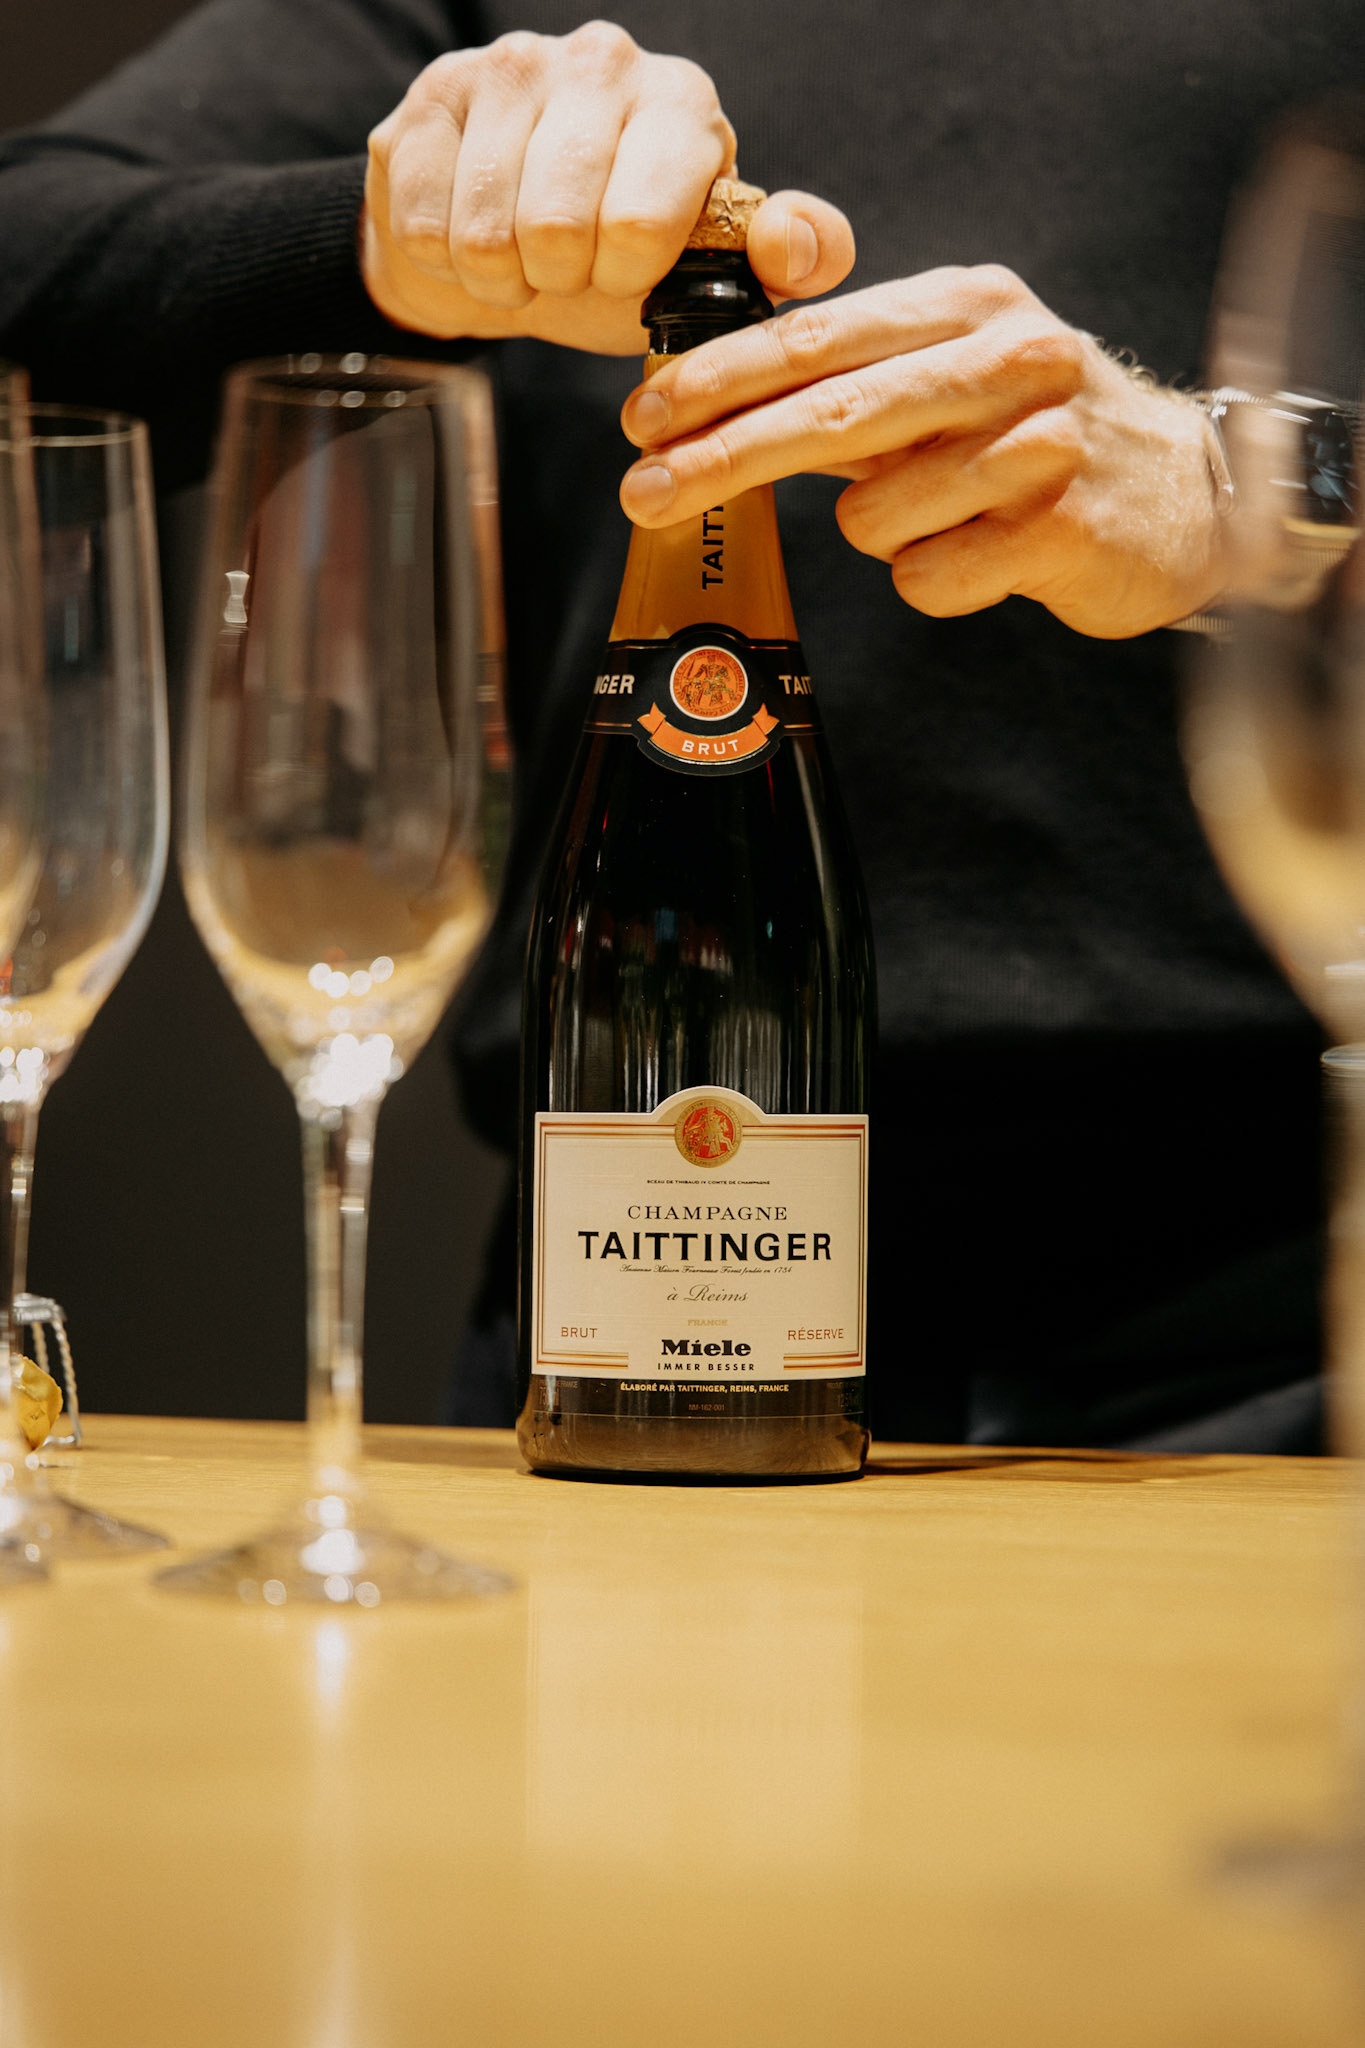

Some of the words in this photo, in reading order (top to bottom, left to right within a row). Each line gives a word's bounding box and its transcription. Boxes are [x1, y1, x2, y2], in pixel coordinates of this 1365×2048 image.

[681, 739, 739, 756] BRUT
[627, 1205, 788, 1221] CHAMPAGNE
[577, 1230, 832, 1262] TAITTINGER
[666, 1287, 678, 1302] à
[683, 1283, 749, 1302] Reims
[687, 1319, 729, 1327] FRANCE
[561, 1326, 598, 1339] BRUT
[787, 1327, 844, 1341] RÉSERVE
[661, 1339, 752, 1357] Miele
[657, 1362, 700, 1371] IMMER
[708, 1363, 755, 1371] BESSER
[620, 1381, 658, 1391] ÉLABORÉ
[659, 1384, 675, 1392] PAR
[677, 1384, 728, 1394] TAITTINGER,
[729, 1384, 757, 1394] REIMS,
[758, 1384, 790, 1393] FRANCE
